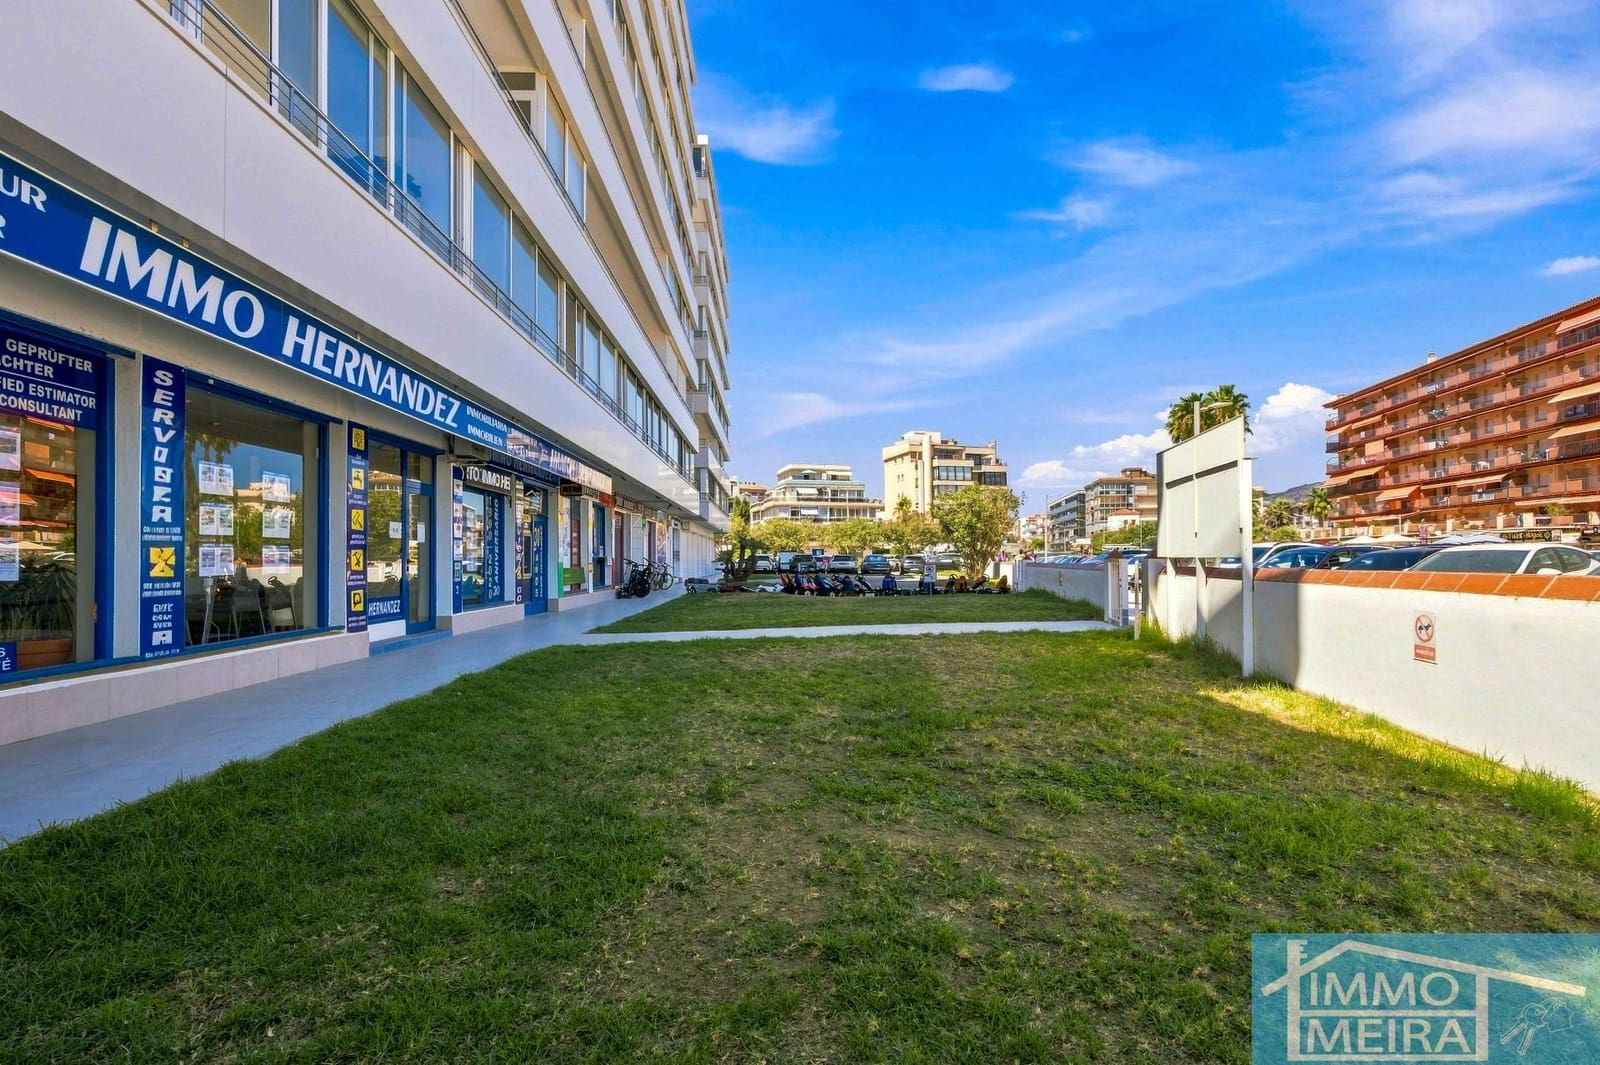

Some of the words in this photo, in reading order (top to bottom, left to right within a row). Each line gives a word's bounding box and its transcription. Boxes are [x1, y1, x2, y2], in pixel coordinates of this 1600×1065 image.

[79, 216, 265, 339] IMMO
[281, 315, 461, 428] HERNANDEZ
[0, 354, 54, 378] CHTER
[5, 338, 93, 373] GEPRÜFTER
[0, 393, 83, 422] CONSULTANT
[28, 383, 96, 409] ESTIMATOR
[368, 599, 401, 617] HERNANDEZ
